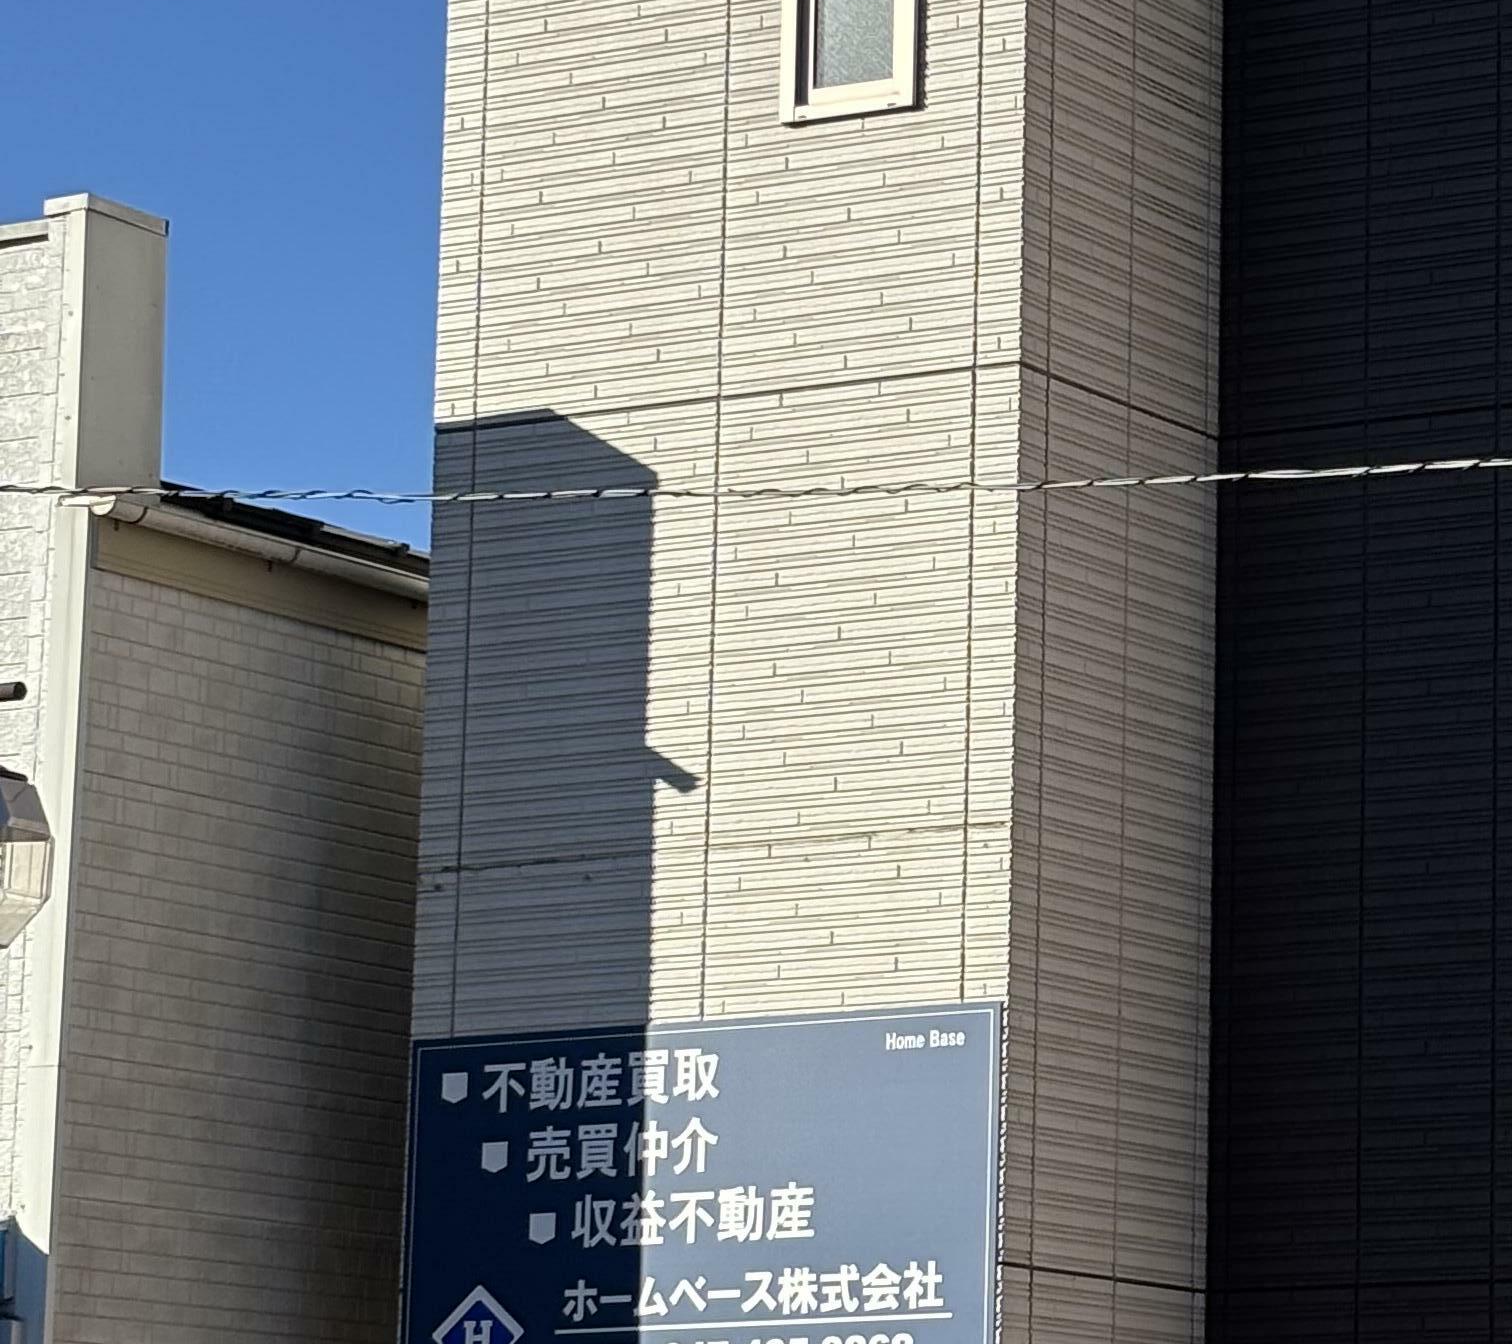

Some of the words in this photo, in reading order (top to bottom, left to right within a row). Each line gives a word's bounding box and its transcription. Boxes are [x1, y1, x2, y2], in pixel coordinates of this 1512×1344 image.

[885, 1032, 926, 1050] Home
[929, 1029, 966, 1048] Base
[482, 1047, 721, 1113] 不動産買取
[525, 1116, 719, 1182] 売買仲介
[571, 1181, 815, 1249] 収益不動産
[561, 1259, 945, 1324] ホームベース株式会社
